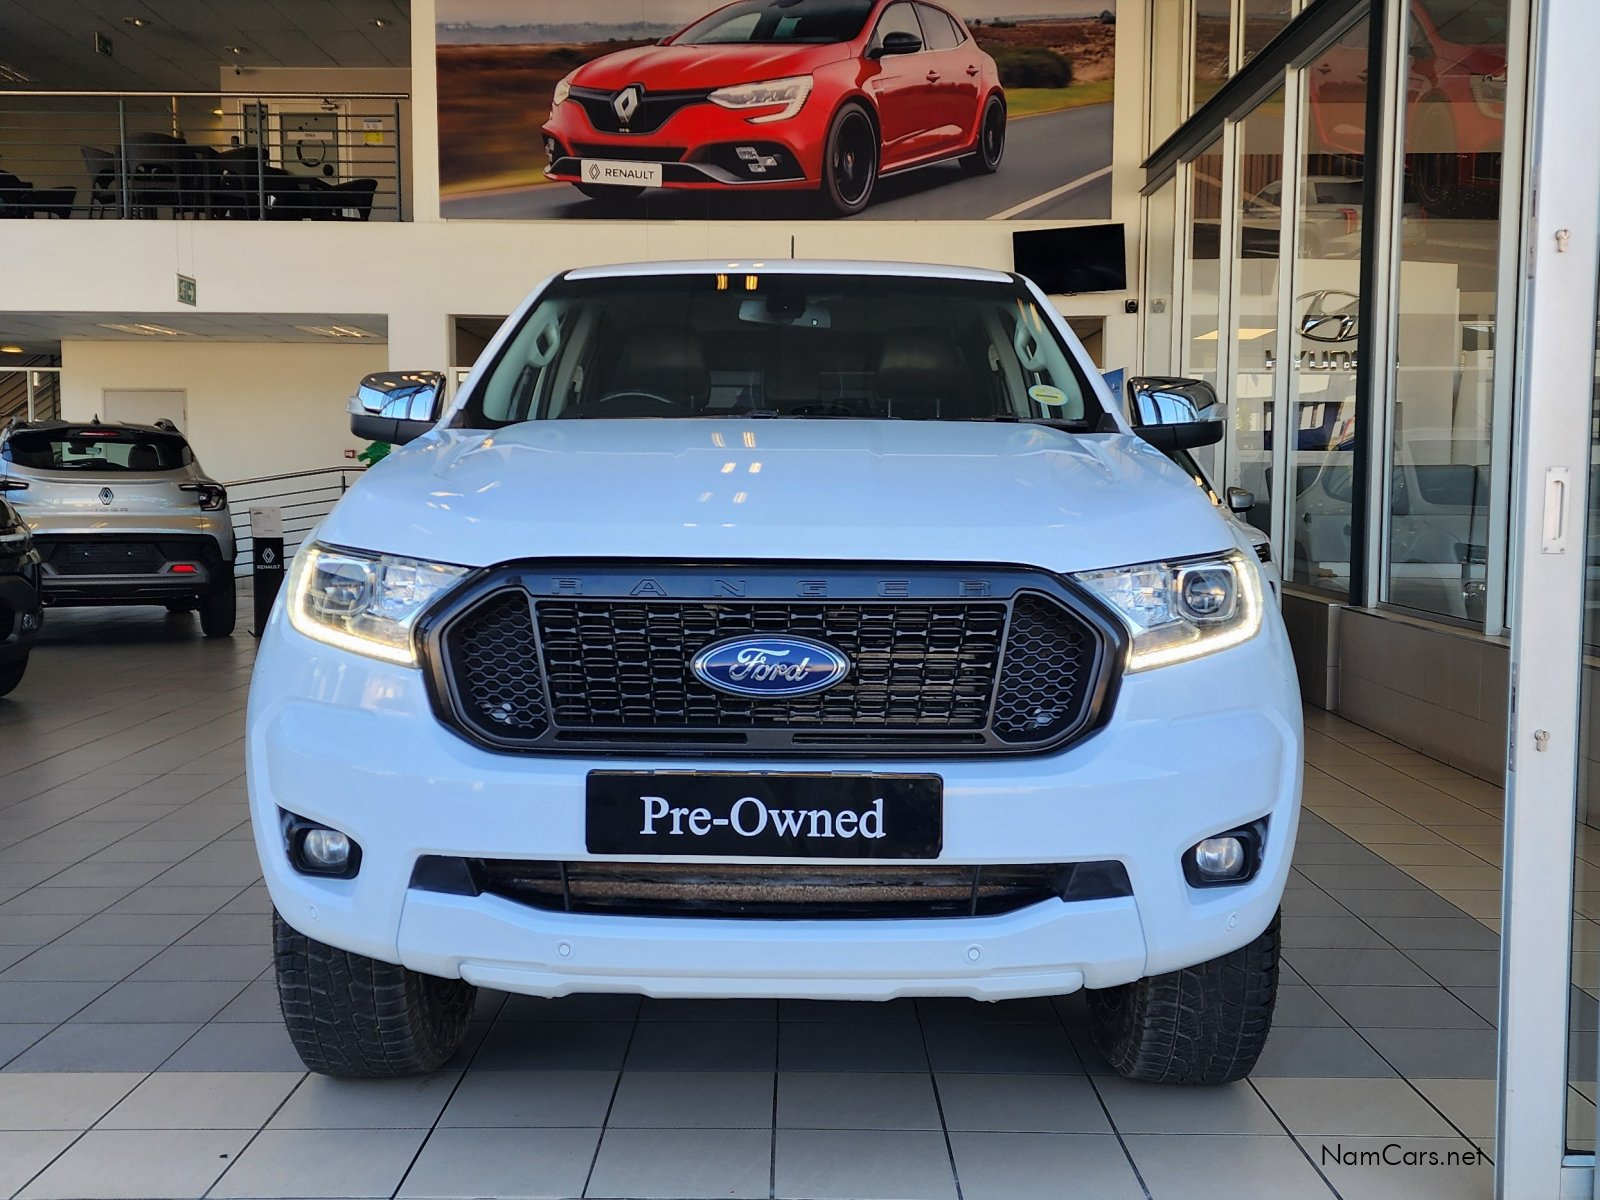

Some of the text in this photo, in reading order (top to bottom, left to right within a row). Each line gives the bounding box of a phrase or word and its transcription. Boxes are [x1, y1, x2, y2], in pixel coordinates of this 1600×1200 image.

[604, 168, 655, 179] RENAULT
[551, 577, 991, 597] RANGER
[728, 647, 810, 682] Ford
[639, 796, 886, 839] Pre-Owned
